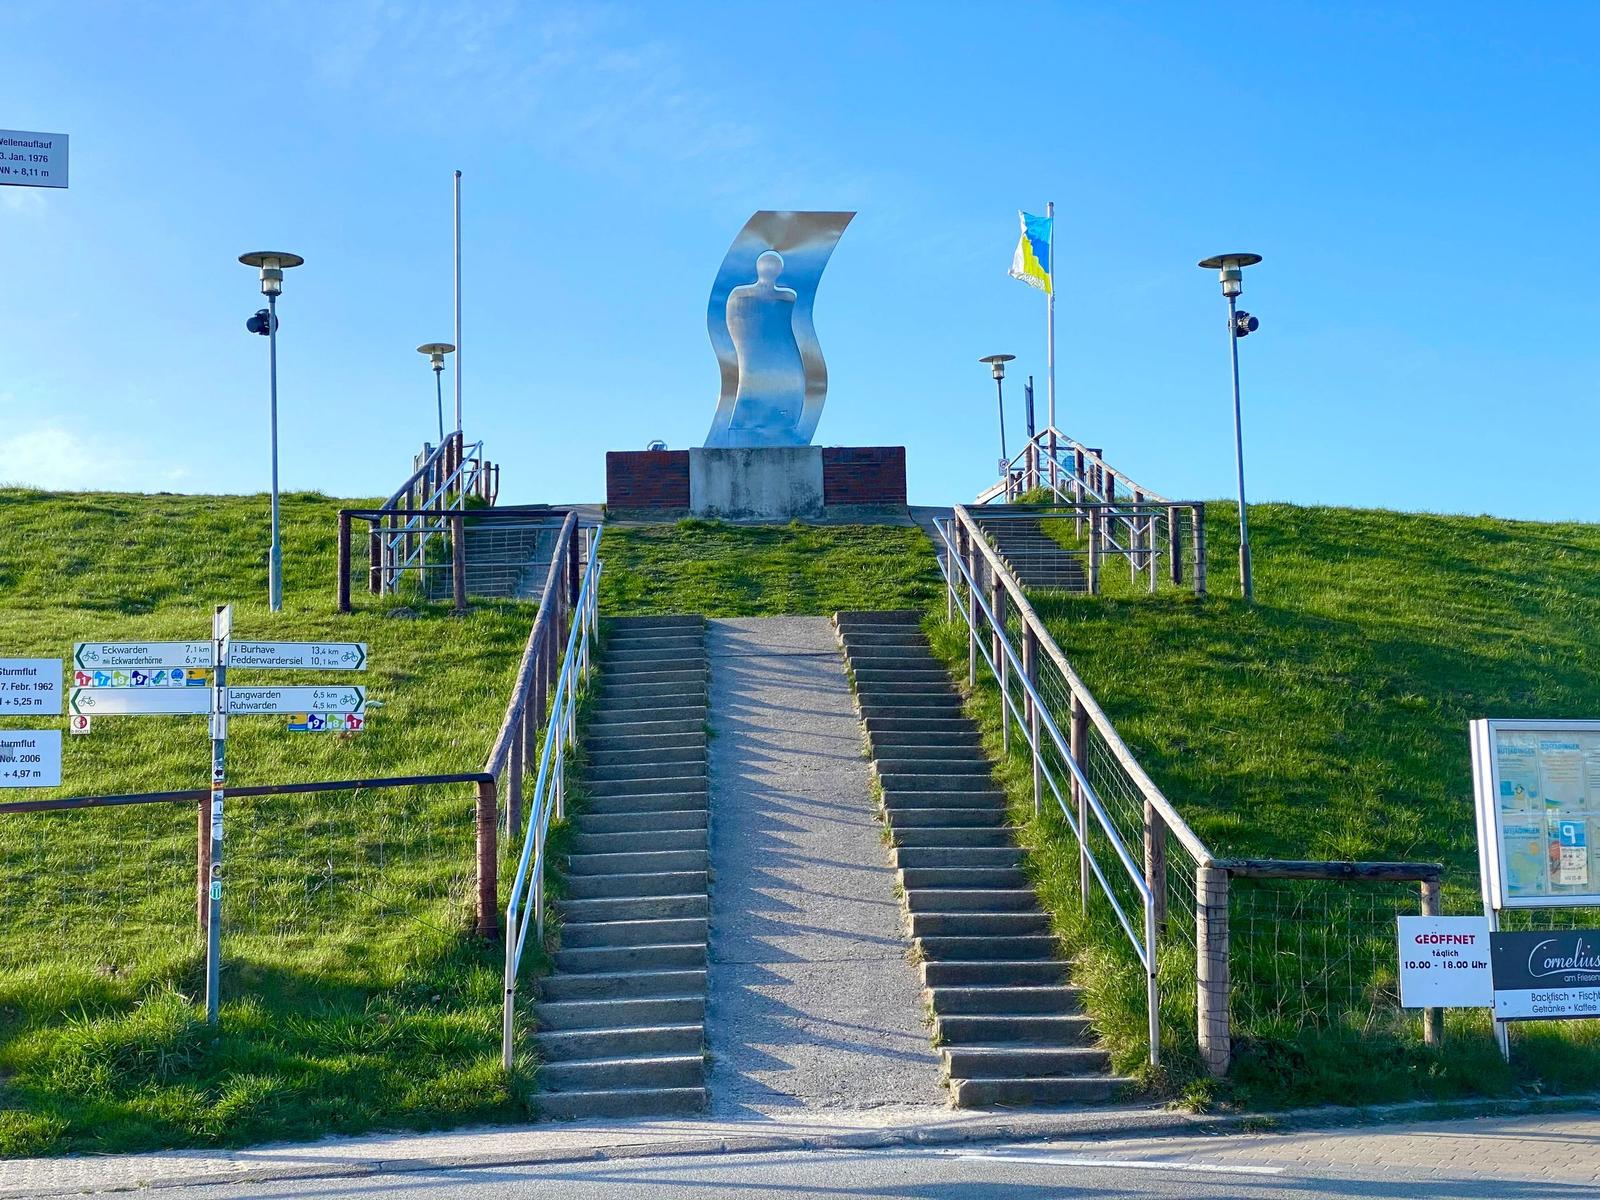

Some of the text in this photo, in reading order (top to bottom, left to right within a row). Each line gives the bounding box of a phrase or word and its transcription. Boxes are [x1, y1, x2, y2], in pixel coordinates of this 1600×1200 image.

[9, 153, 26, 161] Jan.
[29, 154, 49, 163] 1976
[21, 167, 38, 177] 8,11
[102, 646, 148, 655] Eckwarden
[240, 645, 276, 654] Burhave
[111, 656, 163, 665] Eckwarderhörne
[231, 655, 304, 665] Fedderwardersiel
[327, 658, 339, 666] km
[137, 675, 144, 685] 9
[10, 682, 31, 691] Febr.
[33, 682, 54, 691] 1962
[230, 690, 281, 700] Langwarden
[326, 691, 338, 699] km
[13, 697, 32, 707] 5,25
[34, 698, 42, 706] m
[230, 701, 277, 710] Ruhwarden
[313, 719, 319, 728] 9
[0, 739, 36, 748] turmflut
[20, 754, 41, 763] 2006
[12, 769, 31, 779] 4,97
[32, 770, 41, 778] m
[1415, 931, 1476, 945] GEÖFFNET
[1432, 949, 1459, 958] täglich
[1528, 937, 1600, 978] Cornelius
[1404, 961, 1431, 969] 10.00
[1442, 961, 1469, 969] 18.00
[1471, 961, 1488, 969] Uhr
[1531, 992, 1569, 1002] Backfisch
[1532, 1003, 1597, 1013] Getränke Kaffee
